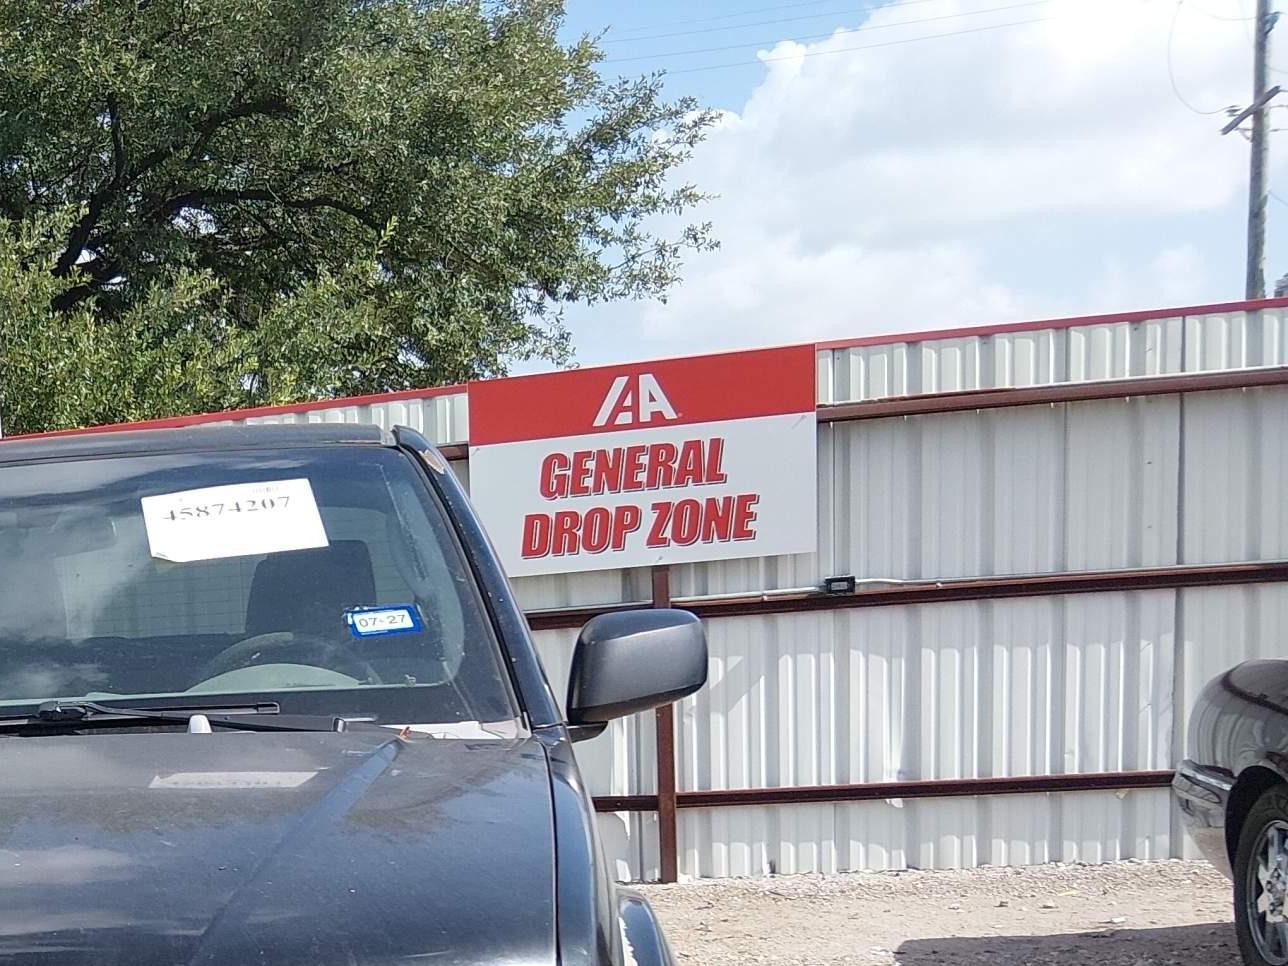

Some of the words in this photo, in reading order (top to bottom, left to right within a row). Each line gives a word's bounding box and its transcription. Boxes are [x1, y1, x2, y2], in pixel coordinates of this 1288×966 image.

[539, 437, 727, 501] GENERAL
[521, 504, 641, 559] DROP
[645, 493, 759, 548] ZONE
[358, 614, 406, 628] 07-27
